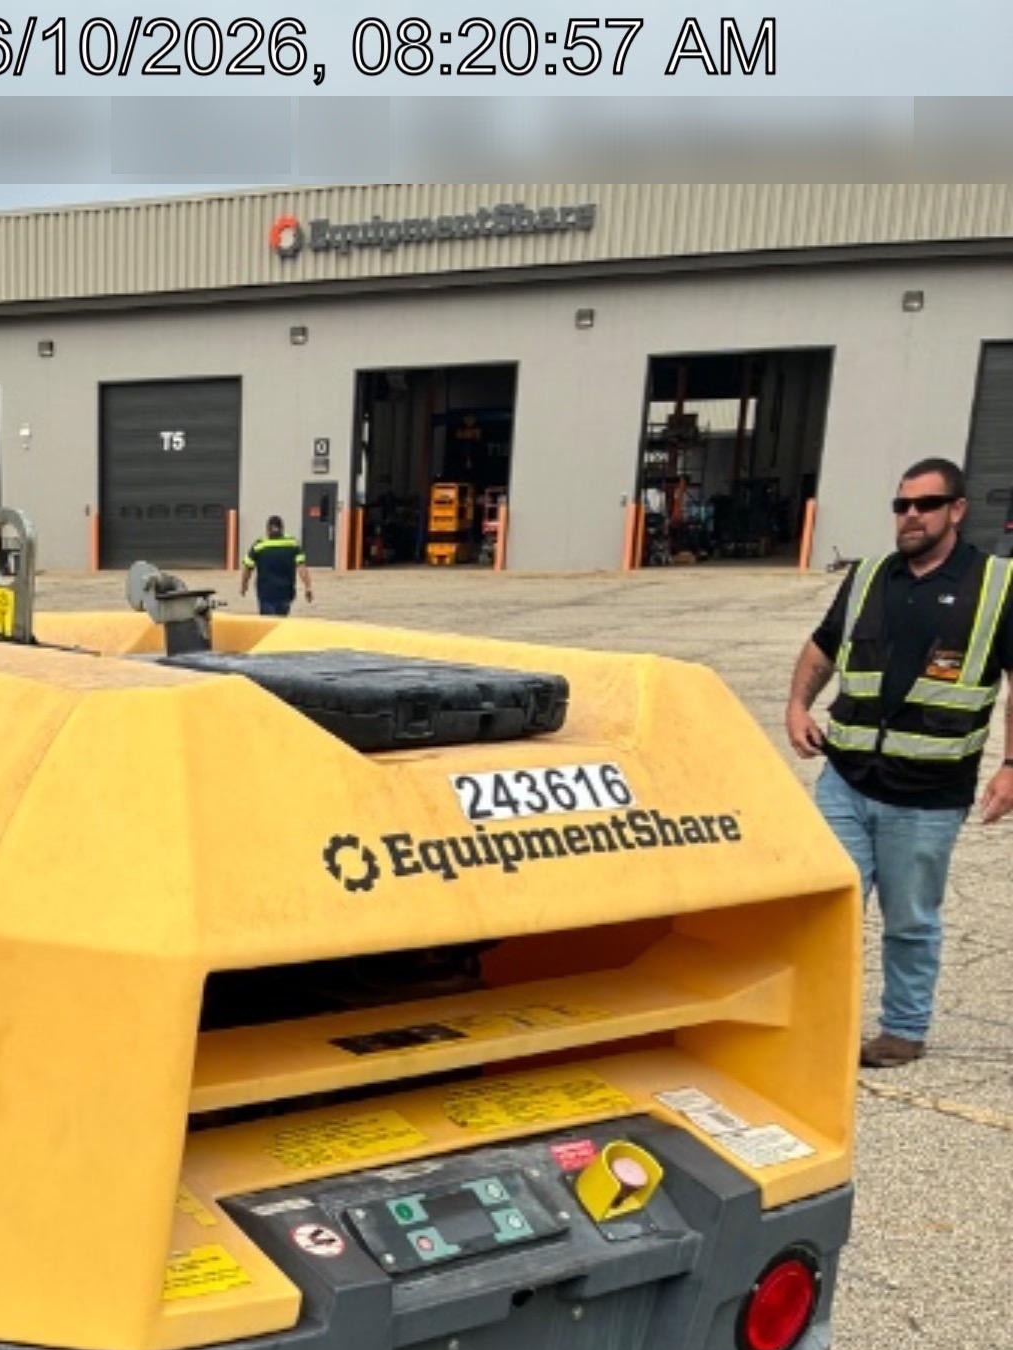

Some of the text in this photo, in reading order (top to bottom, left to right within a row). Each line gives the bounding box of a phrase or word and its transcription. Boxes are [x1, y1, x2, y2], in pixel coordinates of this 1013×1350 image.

[309, 203, 595, 255] EquipmentShare
[160, 430, 186, 451] T5
[455, 764, 633, 820] 243616
[383, 810, 741, 881] EquipmentShare
